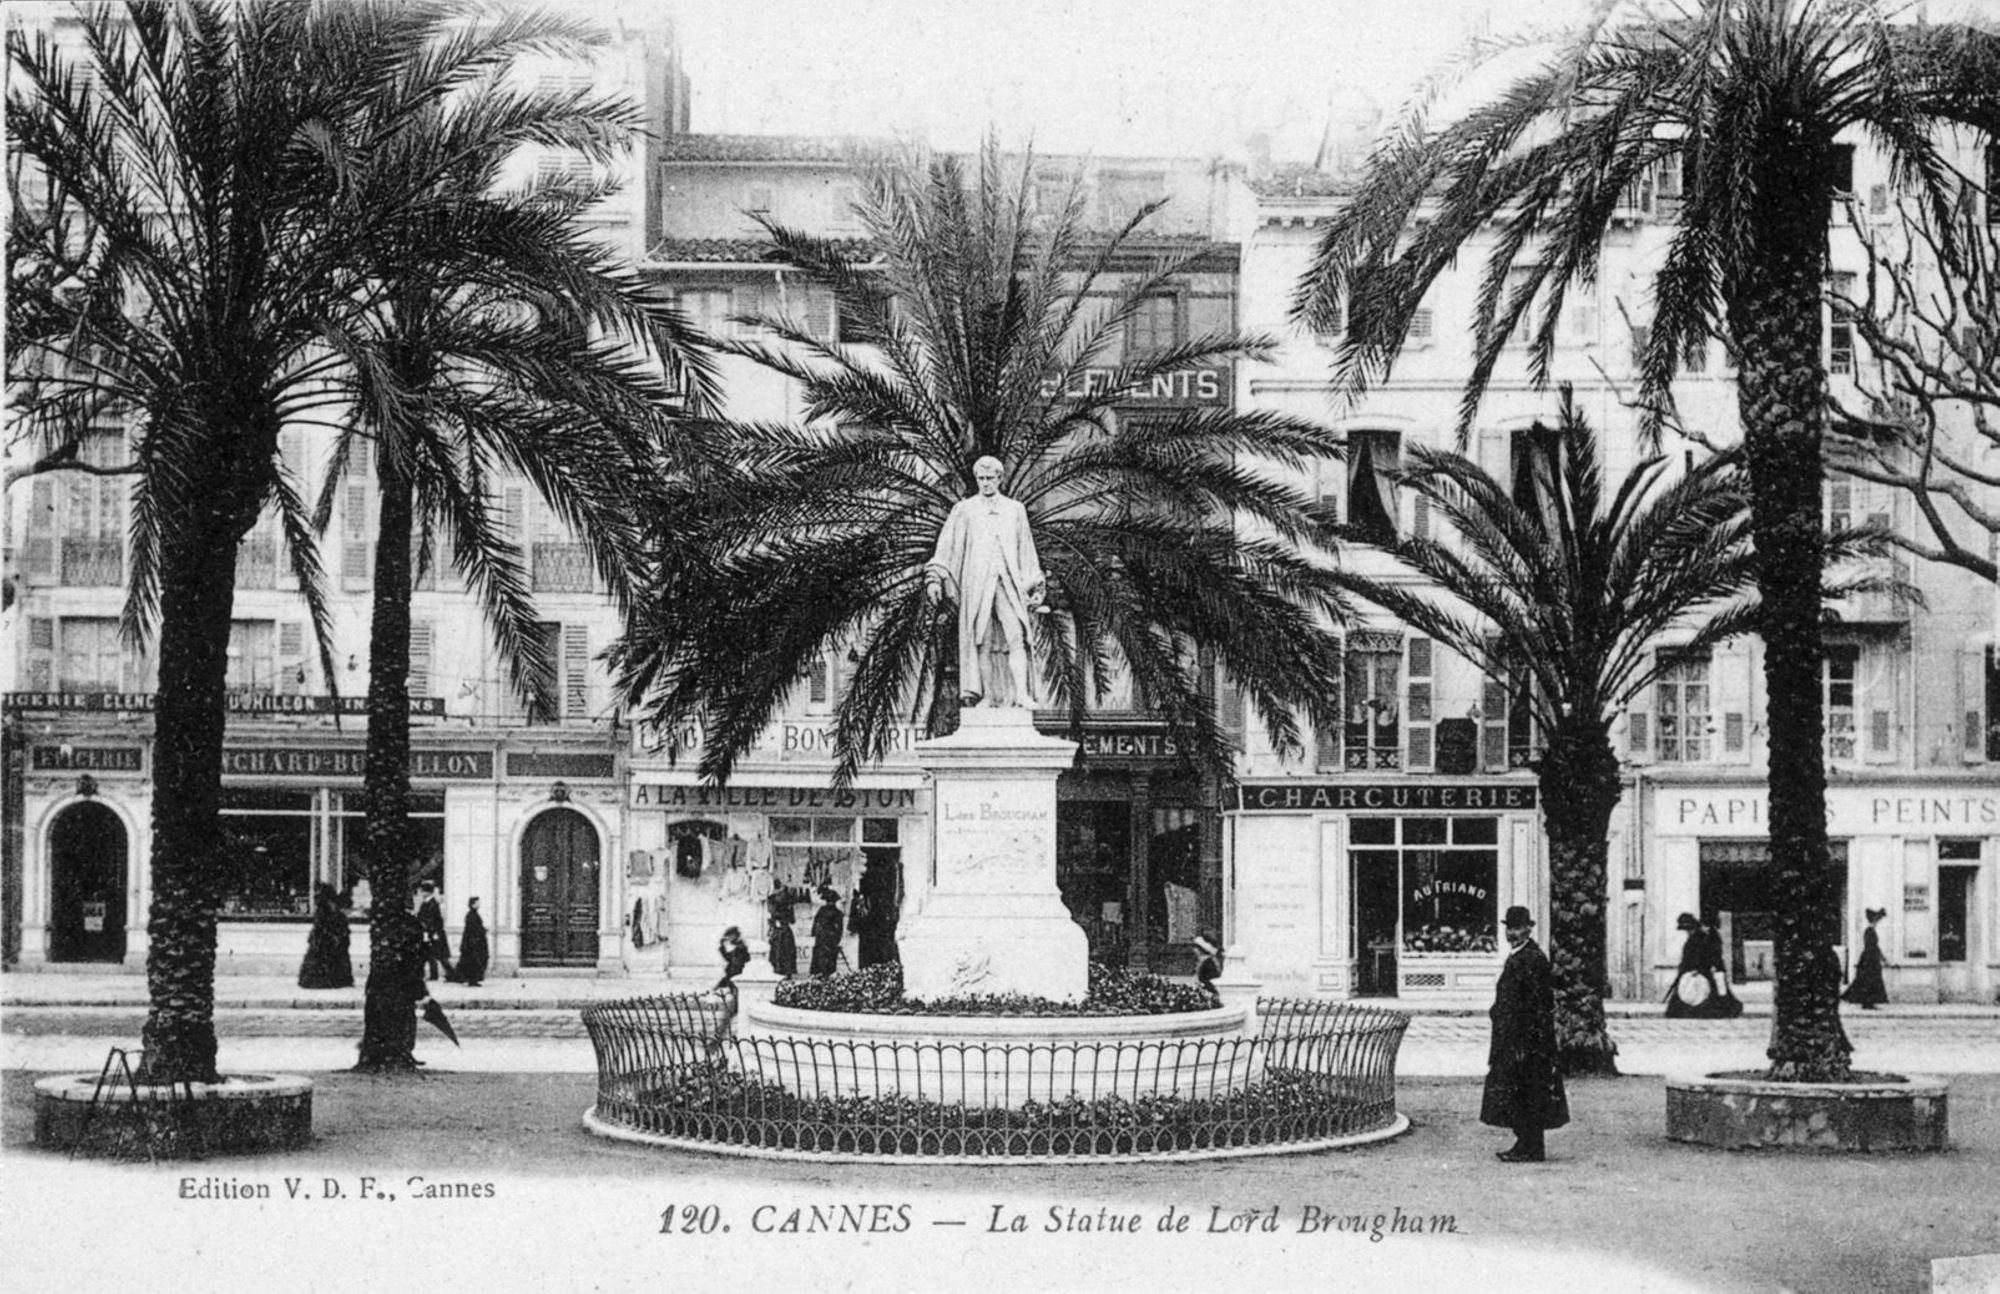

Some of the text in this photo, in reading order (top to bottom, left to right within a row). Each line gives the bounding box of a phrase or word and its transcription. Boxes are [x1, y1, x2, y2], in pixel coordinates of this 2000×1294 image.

[2, 693, 86, 706] ICERIE
[783, 726, 928, 751] BONRIE
[1083, 735, 1177, 755] EMENTS
[657, 786, 686, 804] LA
[1258, 788, 1523, 807] CHARCUTERIE
[1679, 799, 1998, 824] PAPIS PEINTS
[1413, 879, 1487, 901] AU FRIAND
